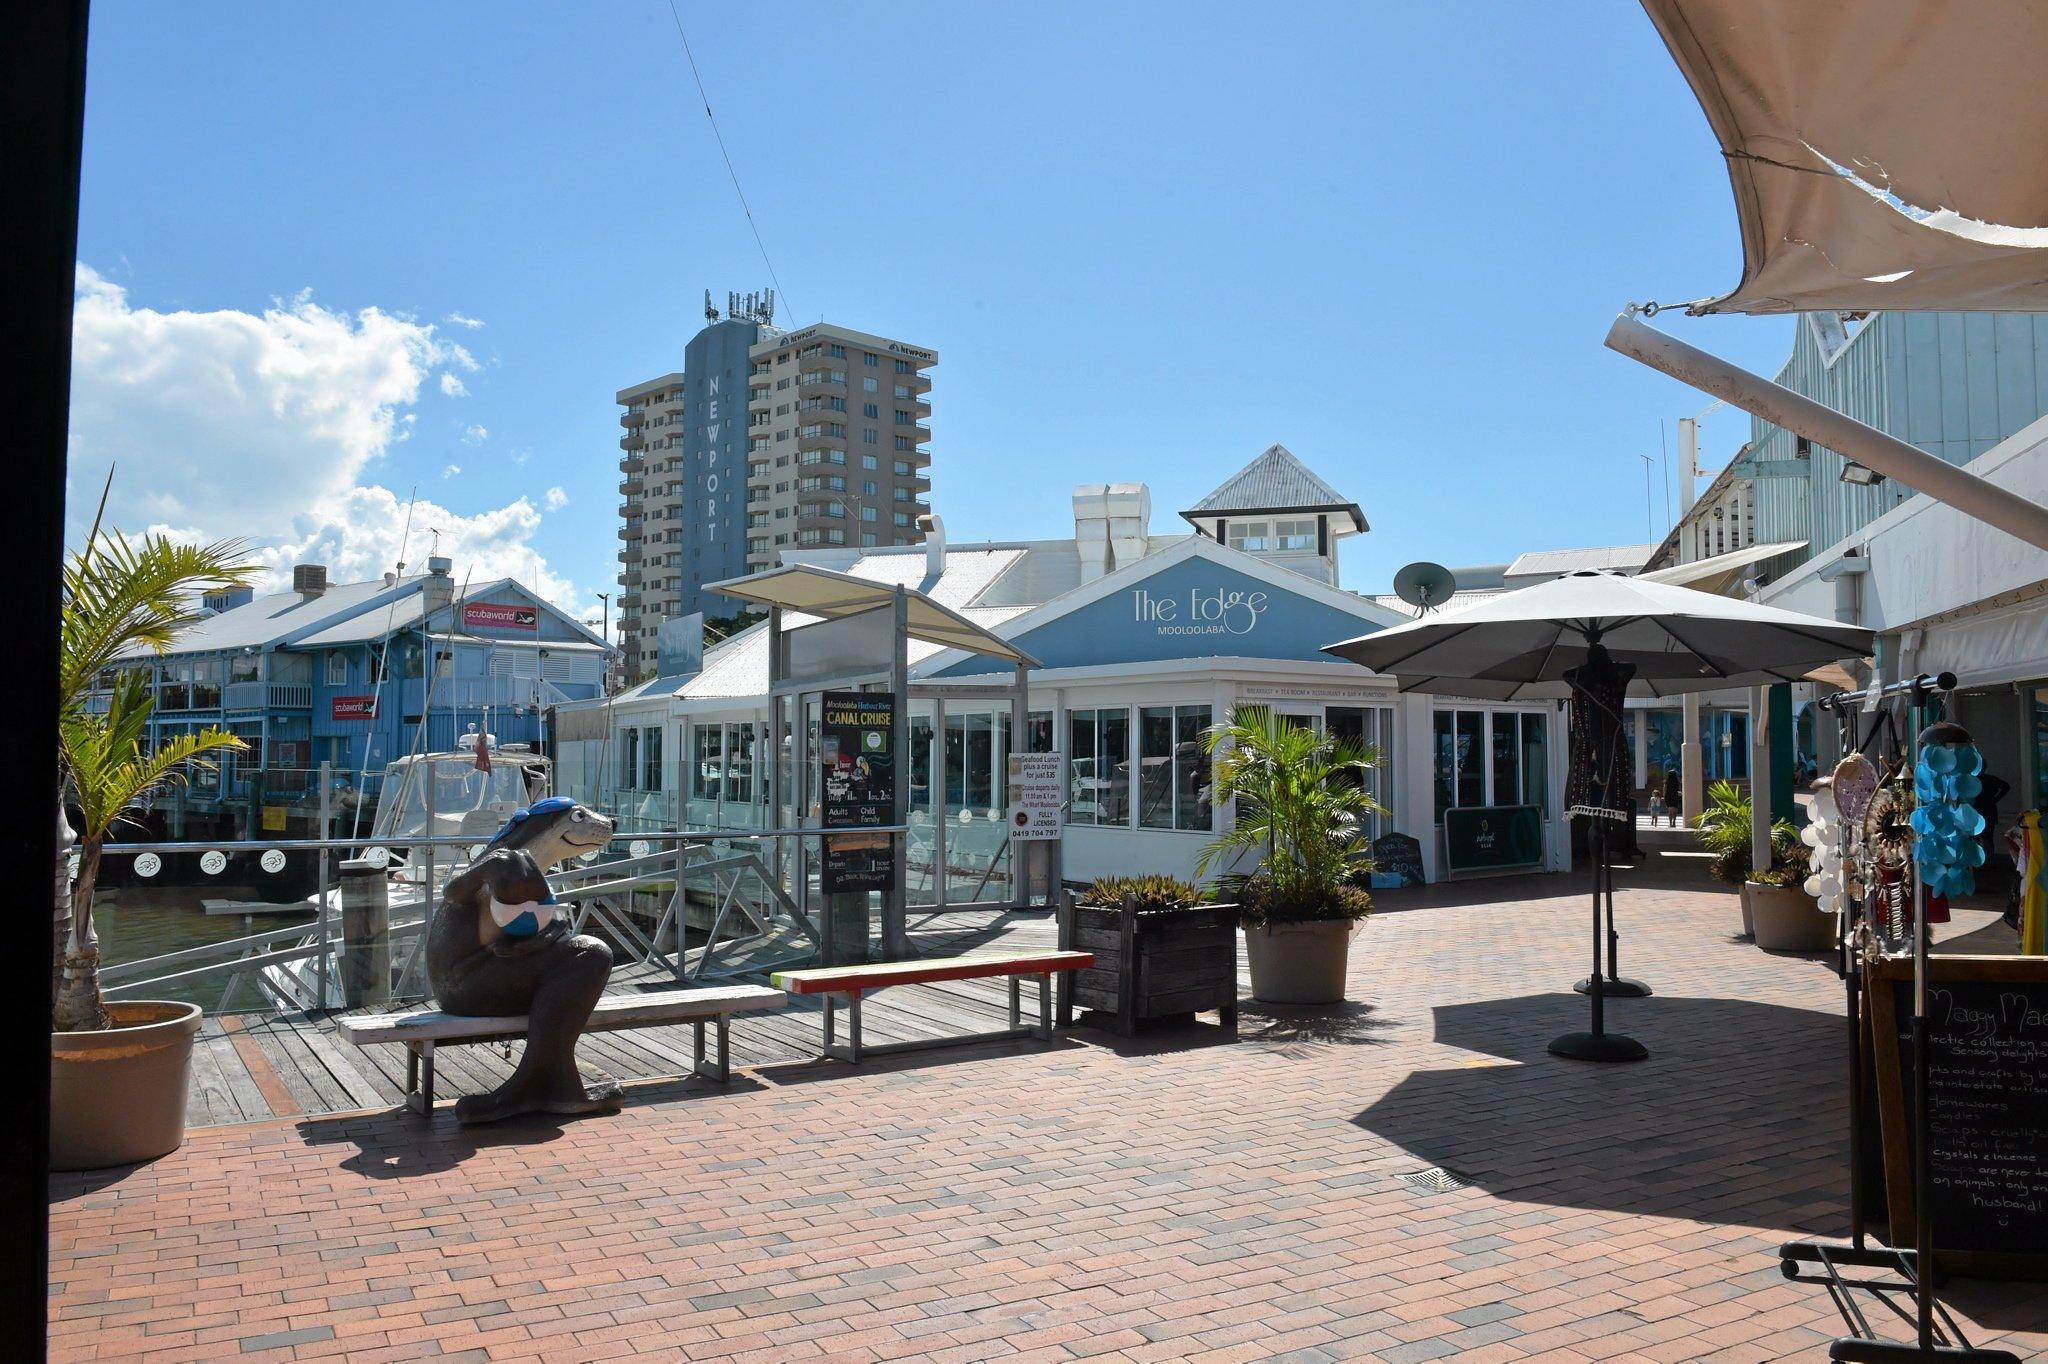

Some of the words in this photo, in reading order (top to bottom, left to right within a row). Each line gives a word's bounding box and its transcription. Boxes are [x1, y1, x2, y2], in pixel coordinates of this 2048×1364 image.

[790, 329, 816, 343] NEWPORT
[900, 345, 931, 360] NEWPORT
[707, 375, 721, 542] NEWPORT
[467, 608, 515, 622] scubaworld
[1132, 590, 1177, 621] The
[1191, 587, 1267, 634] Edge
[1157, 625, 1225, 635] MOOLOOLABA
[334, 701, 363, 713] scubaworld
[827, 711, 859, 725] CANAL
[860, 712, 891, 725] CRUISE
[1021, 755, 1042, 763] Seafood
[1044, 755, 1060, 763] Lunch
[1023, 763, 1035, 771] plus
[1035, 771, 1045, 780] just
[1046, 771, 1055, 779] $35
[1050, 784, 1060, 792] daily
[828, 808, 848, 816] Adults
[860, 807, 876, 815] Child
[860, 815, 880, 824] Family
[1929, 1034, 1965, 1045] lectic
[1970, 1035, 2035, 1051] collection
[1951, 1046, 1999, 1063] Sensory
[2001, 1049, 2048, 1064] delights
[1952, 1067, 1976, 1075] and
[1978, 1069, 2014, 1079] crafts
[2020, 1070, 2034, 1086] by
[2038, 1069, 2048, 1079] lo
[1947, 1079, 2004, 1090] interstate
[2010, 1085, 2048, 1093] artisa
[1932, 1149, 1978, 1160] Crystals
[1993, 1153, 2038, 1162] Incense
[1978, 1167, 1998, 1175] are
[2000, 1168, 2031, 1179] never
[2035, 1167, 2048, 1177] te
[1933, 1177, 1951, 1188] on
[2005, 1180, 2029, 1197] only
[1972, 1193, 2042, 1212] husband!
